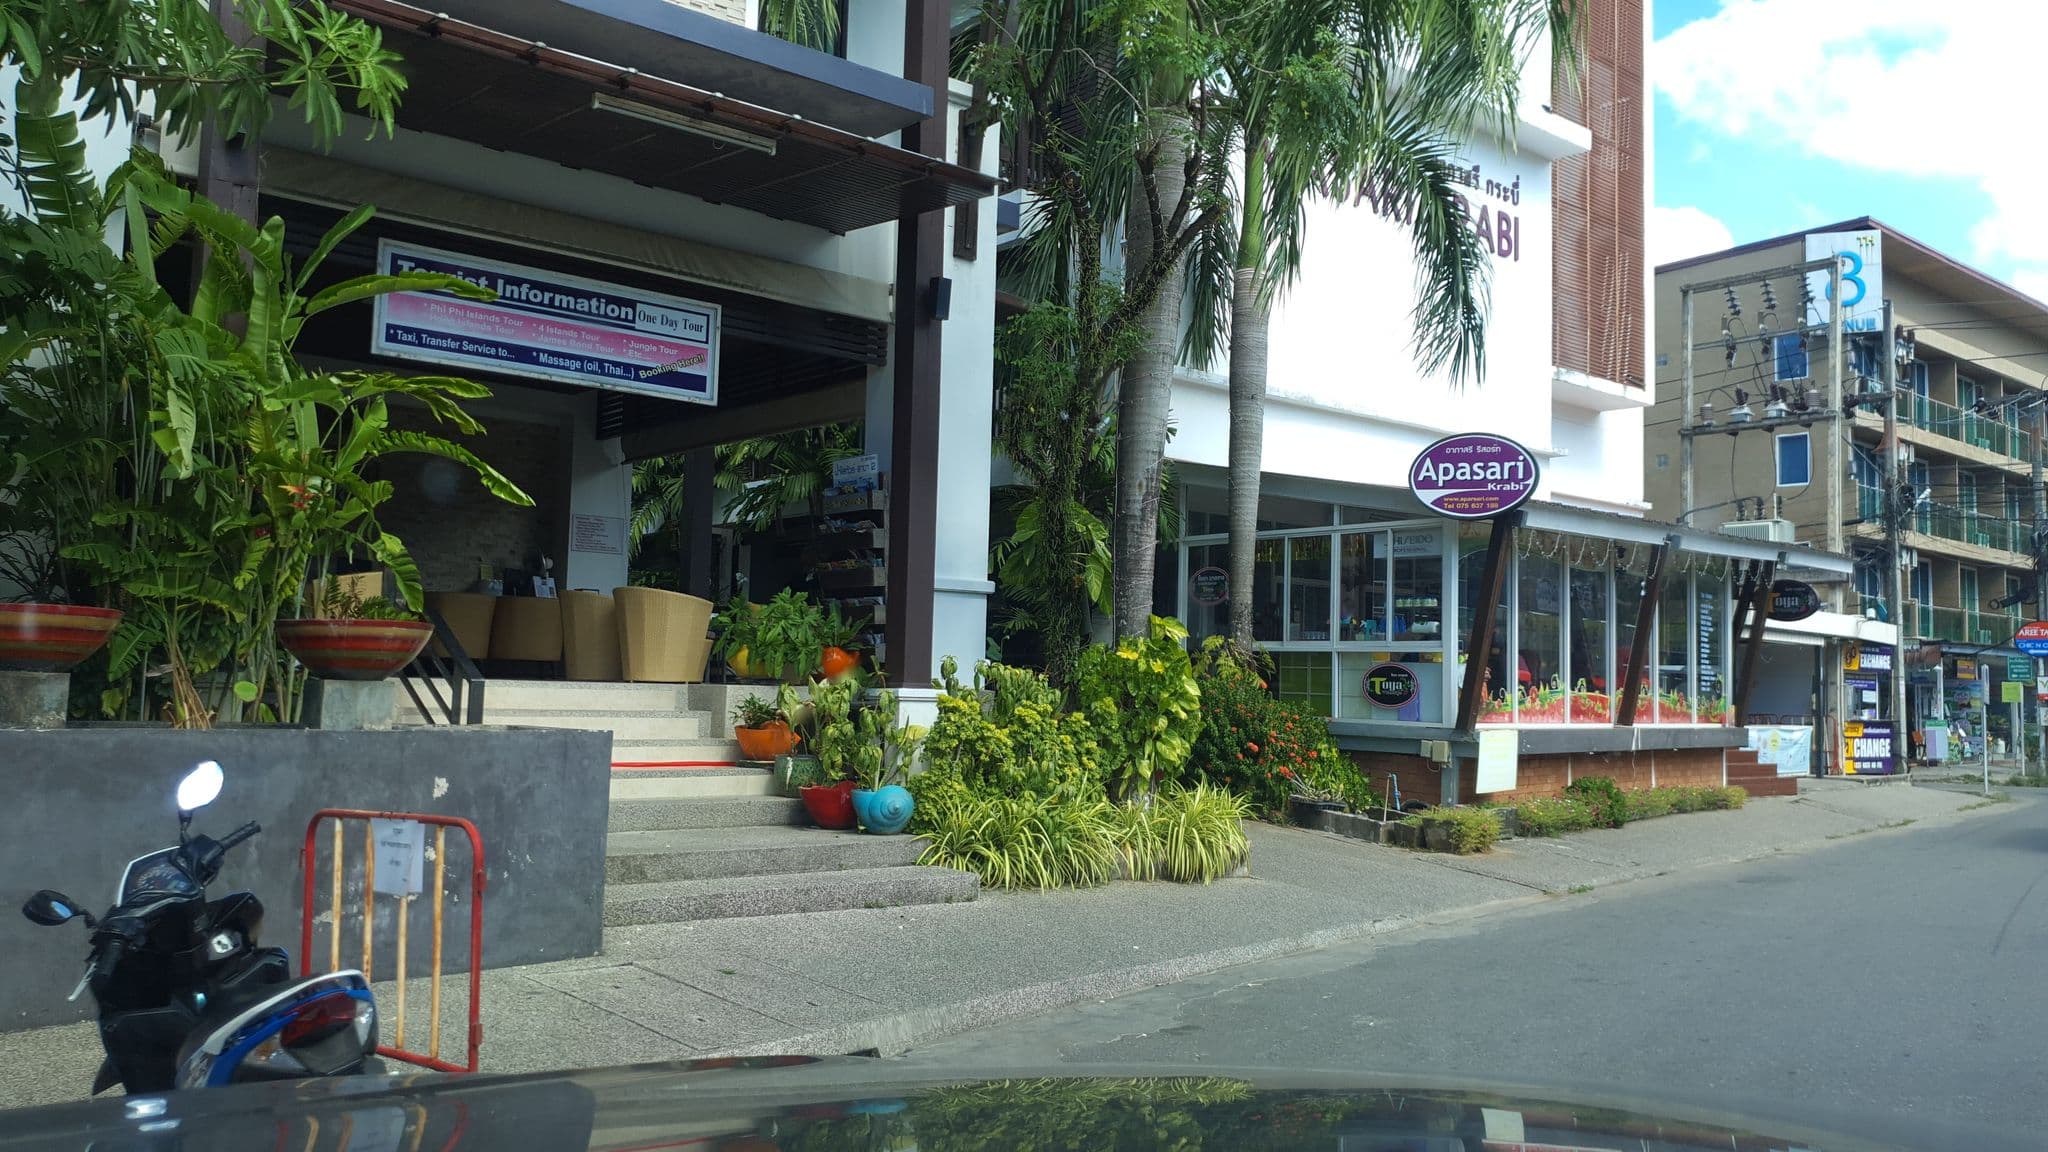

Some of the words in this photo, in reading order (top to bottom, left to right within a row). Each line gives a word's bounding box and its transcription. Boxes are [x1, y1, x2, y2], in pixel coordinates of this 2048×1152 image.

[497, 279, 634, 320] Information
[430, 303, 446, 314] Phi
[449, 306, 464, 317] Phi
[467, 310, 500, 323] Islands
[503, 315, 524, 328] Tour
[638, 310, 657, 325] One
[660, 314, 679, 331] Day
[682, 318, 705, 333] Tour
[396, 330, 418, 344] Taxi,
[421, 334, 460, 349] Transfer
[462, 340, 497, 355] Service
[546, 326, 579, 338] Islands
[582, 331, 601, 342] Tour
[628, 341, 657, 353] Jungle
[659, 345, 679, 356] Tour
[539, 352, 581, 370] Massage
[583, 359, 601, 374] (oil,
[639, 362, 678, 379] Booking
[1418, 455, 1524, 487] Apasari
[1487, 481, 1524, 491] Krabi
